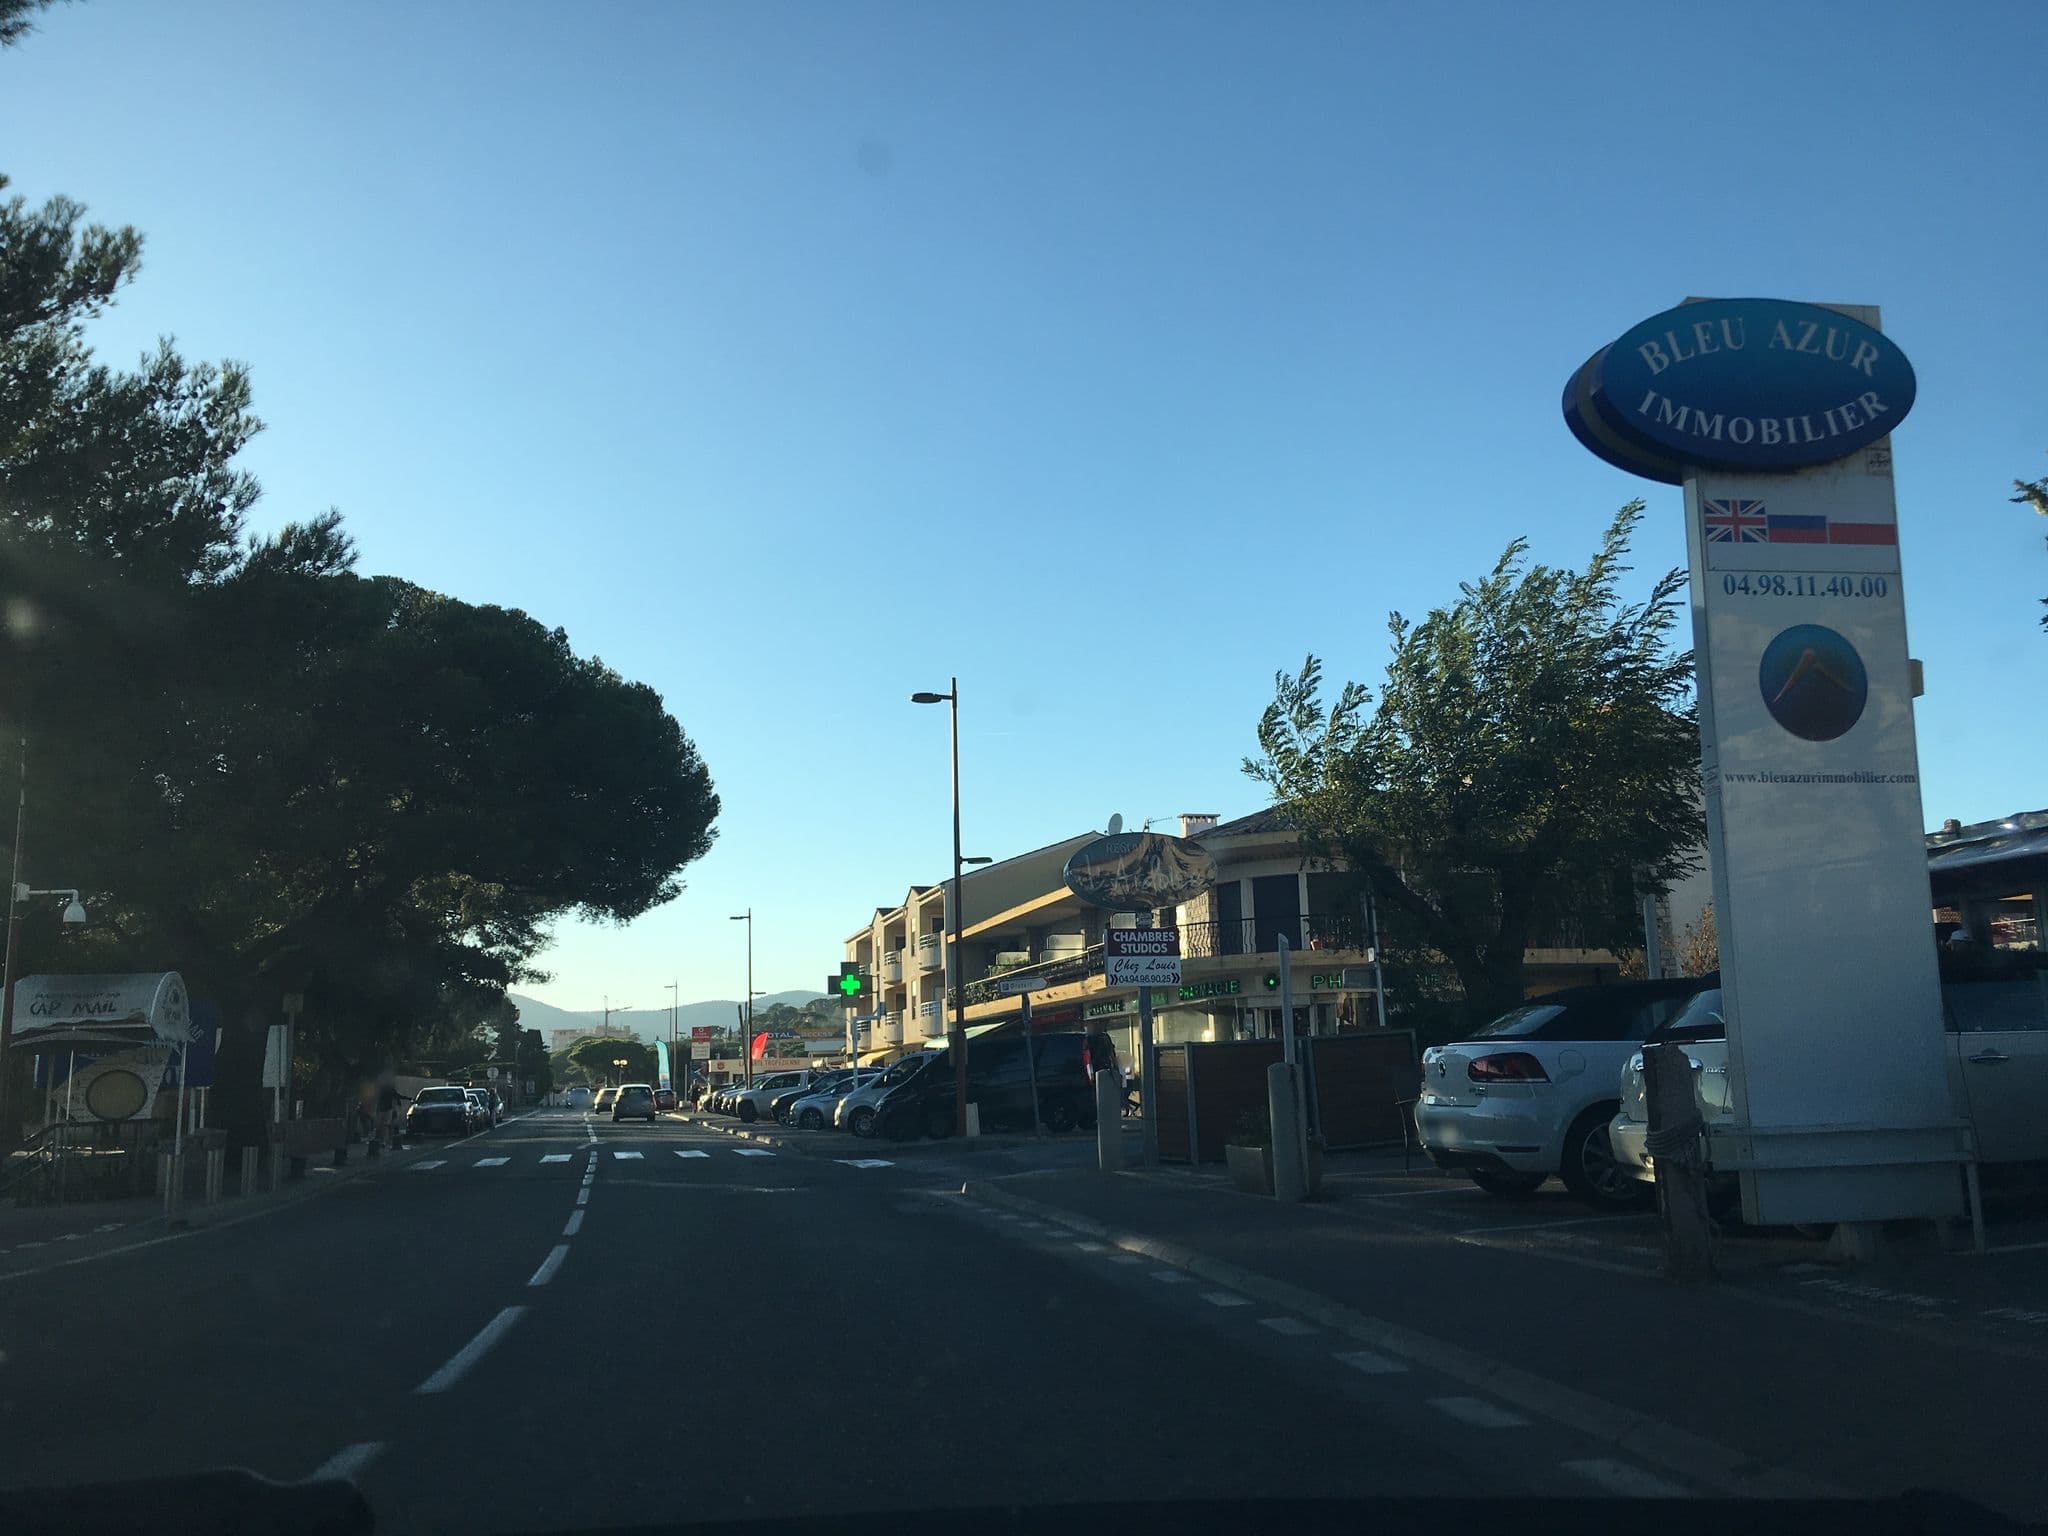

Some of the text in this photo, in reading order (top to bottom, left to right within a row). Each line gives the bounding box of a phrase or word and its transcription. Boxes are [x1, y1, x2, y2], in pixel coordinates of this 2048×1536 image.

[1637, 317, 1880, 377] BLEU AZUR
[1636, 389, 1889, 446] IMMOBILIER
[1723, 573, 1887, 598] 04.98.11.40.00
[1724, 769, 1917, 785] www.bleuazurimmobilier.com
[1112, 931, 1176, 942] CHAMBRES
[1119, 943, 1168, 954] STUDIOS
[1114, 957, 1176, 974] Chez Louis
[1178, 978, 1240, 1000] PHARMACIE
[768, 1031, 793, 1039] OTAL
